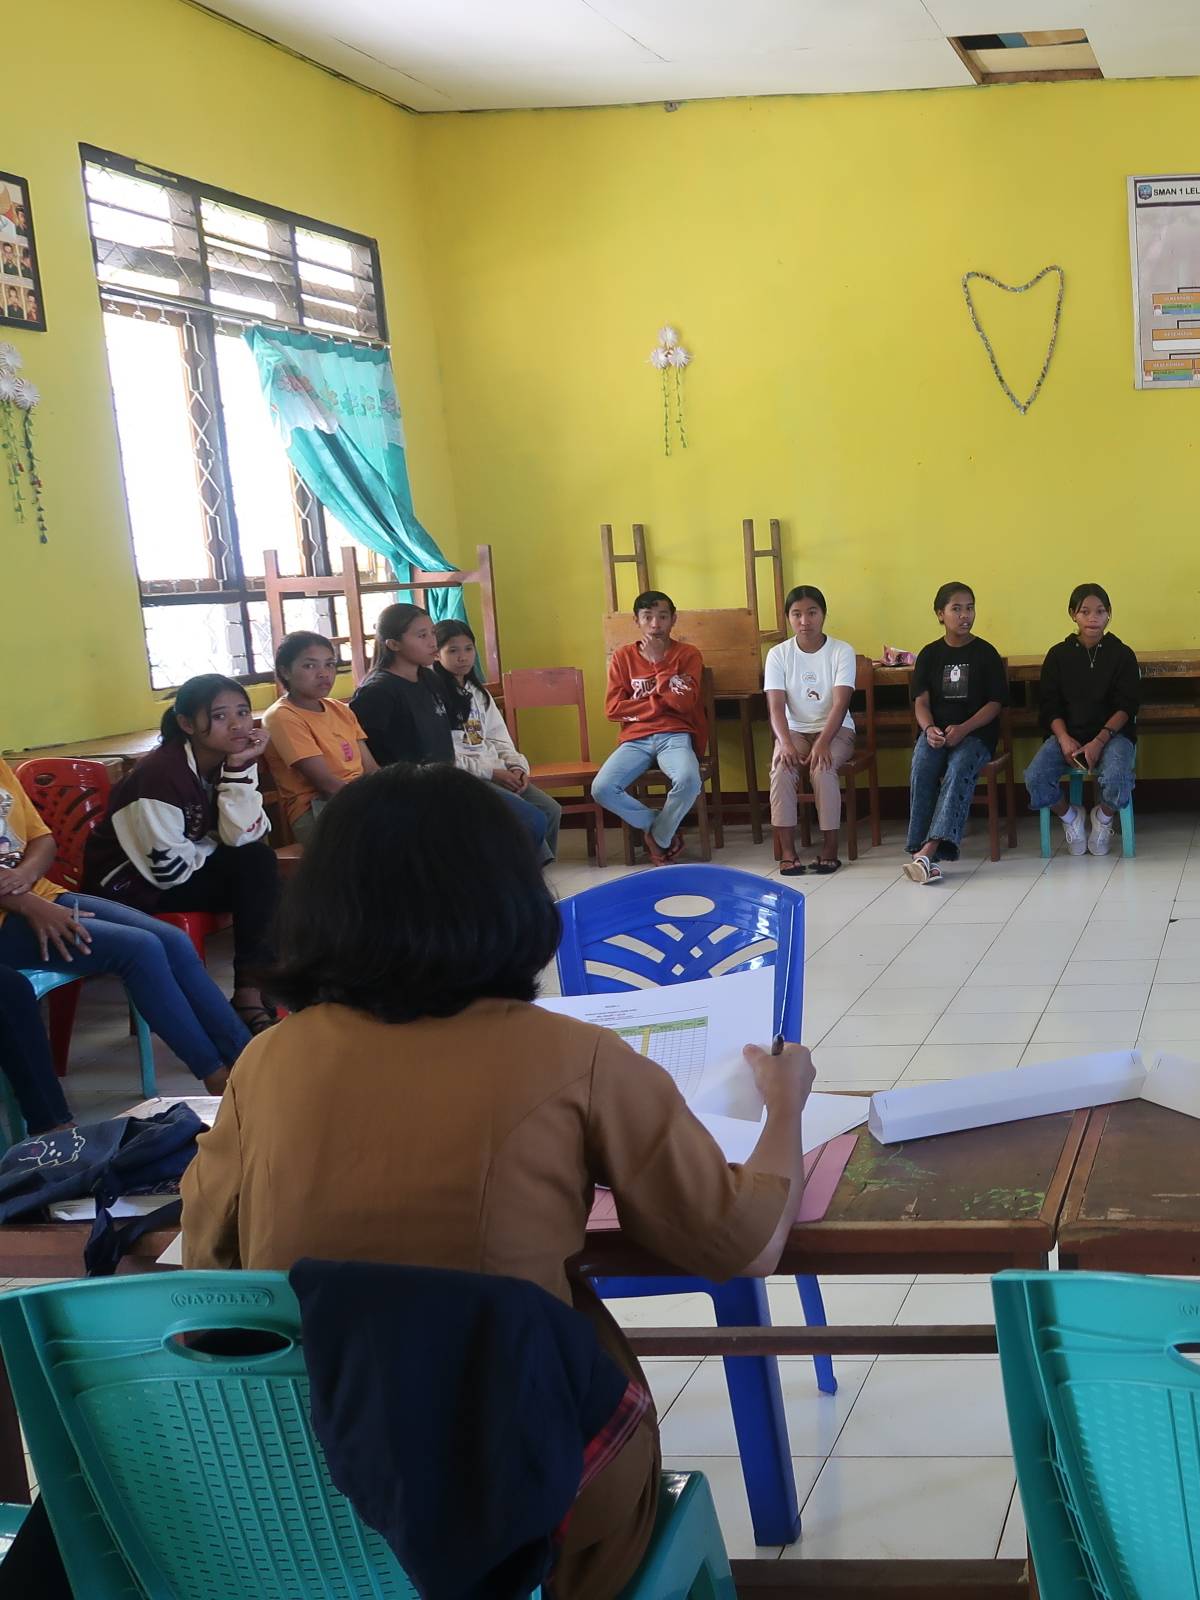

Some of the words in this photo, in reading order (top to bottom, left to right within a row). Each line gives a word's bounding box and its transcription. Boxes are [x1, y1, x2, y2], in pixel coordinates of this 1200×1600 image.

[1153, 188, 1177, 197] SMAN
[1178, 187, 1183, 196] 1
[180, 1291, 261, 1307] NAPOLLY
